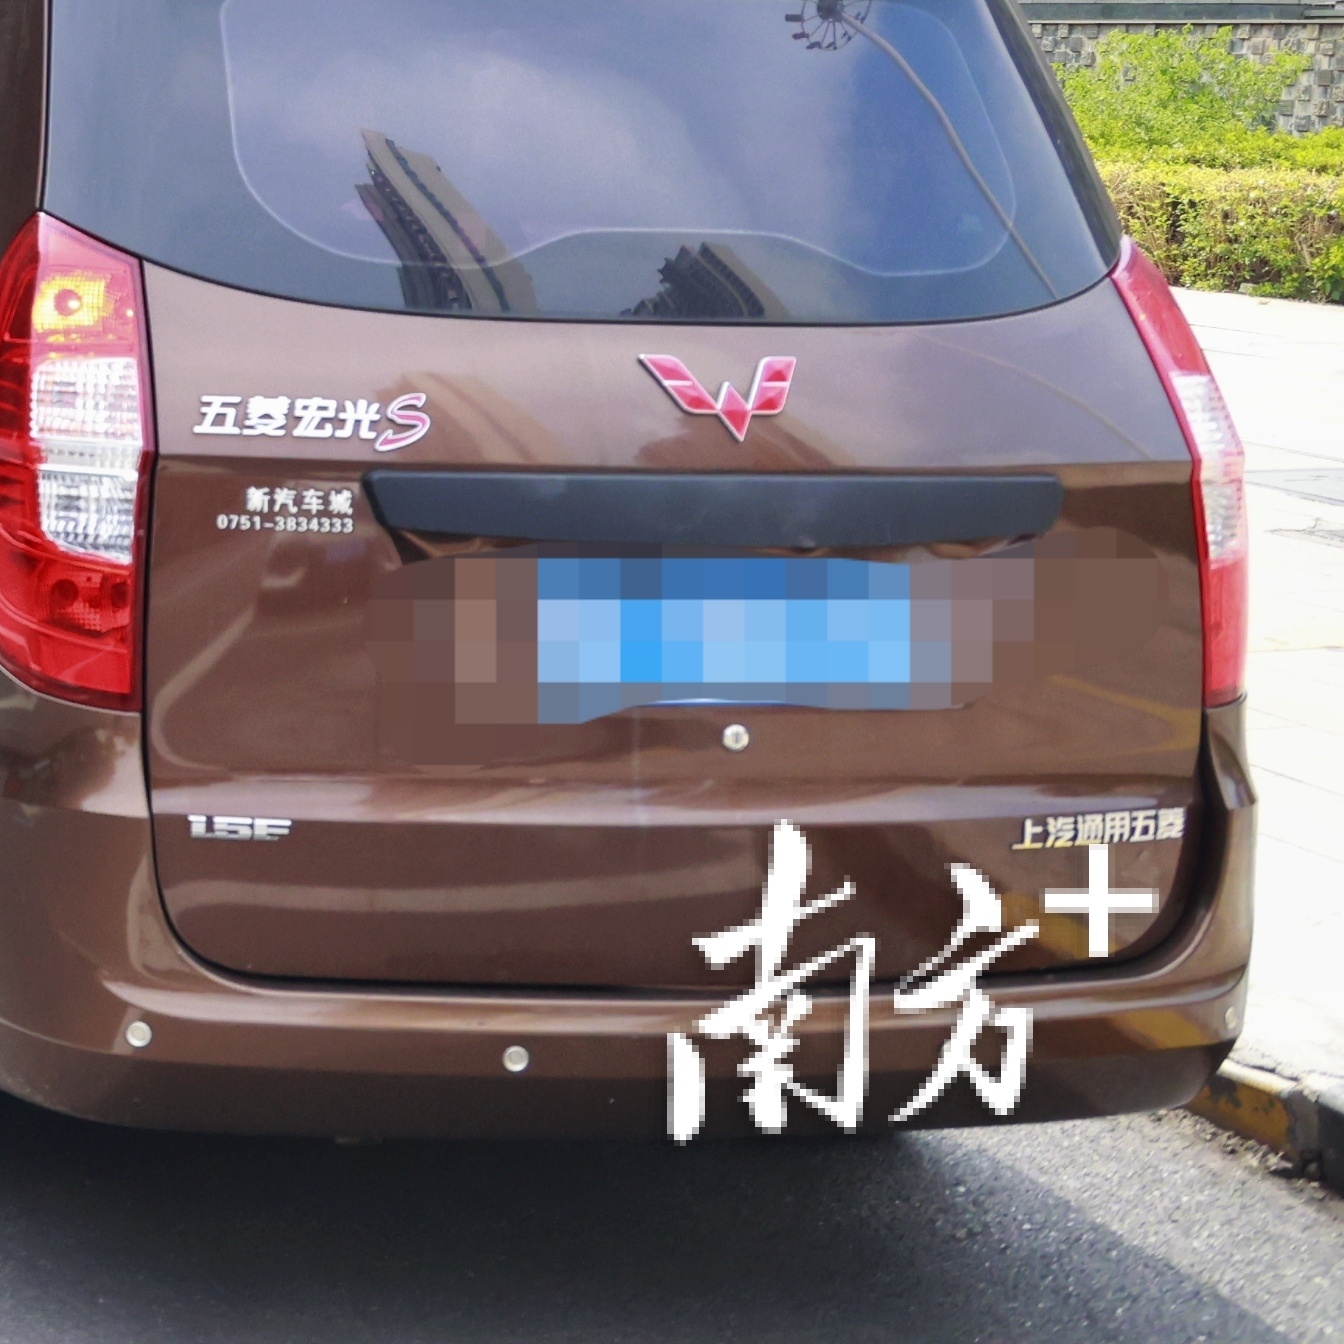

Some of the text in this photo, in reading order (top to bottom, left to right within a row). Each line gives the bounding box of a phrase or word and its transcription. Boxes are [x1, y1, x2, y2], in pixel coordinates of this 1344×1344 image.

[192, 392, 431, 452] 五菱宏光S
[245, 486, 354, 515] 新汽车城
[216, 513, 354, 534] 0751-3834333
[1012, 806, 1187, 851] 上汽通用五菱
